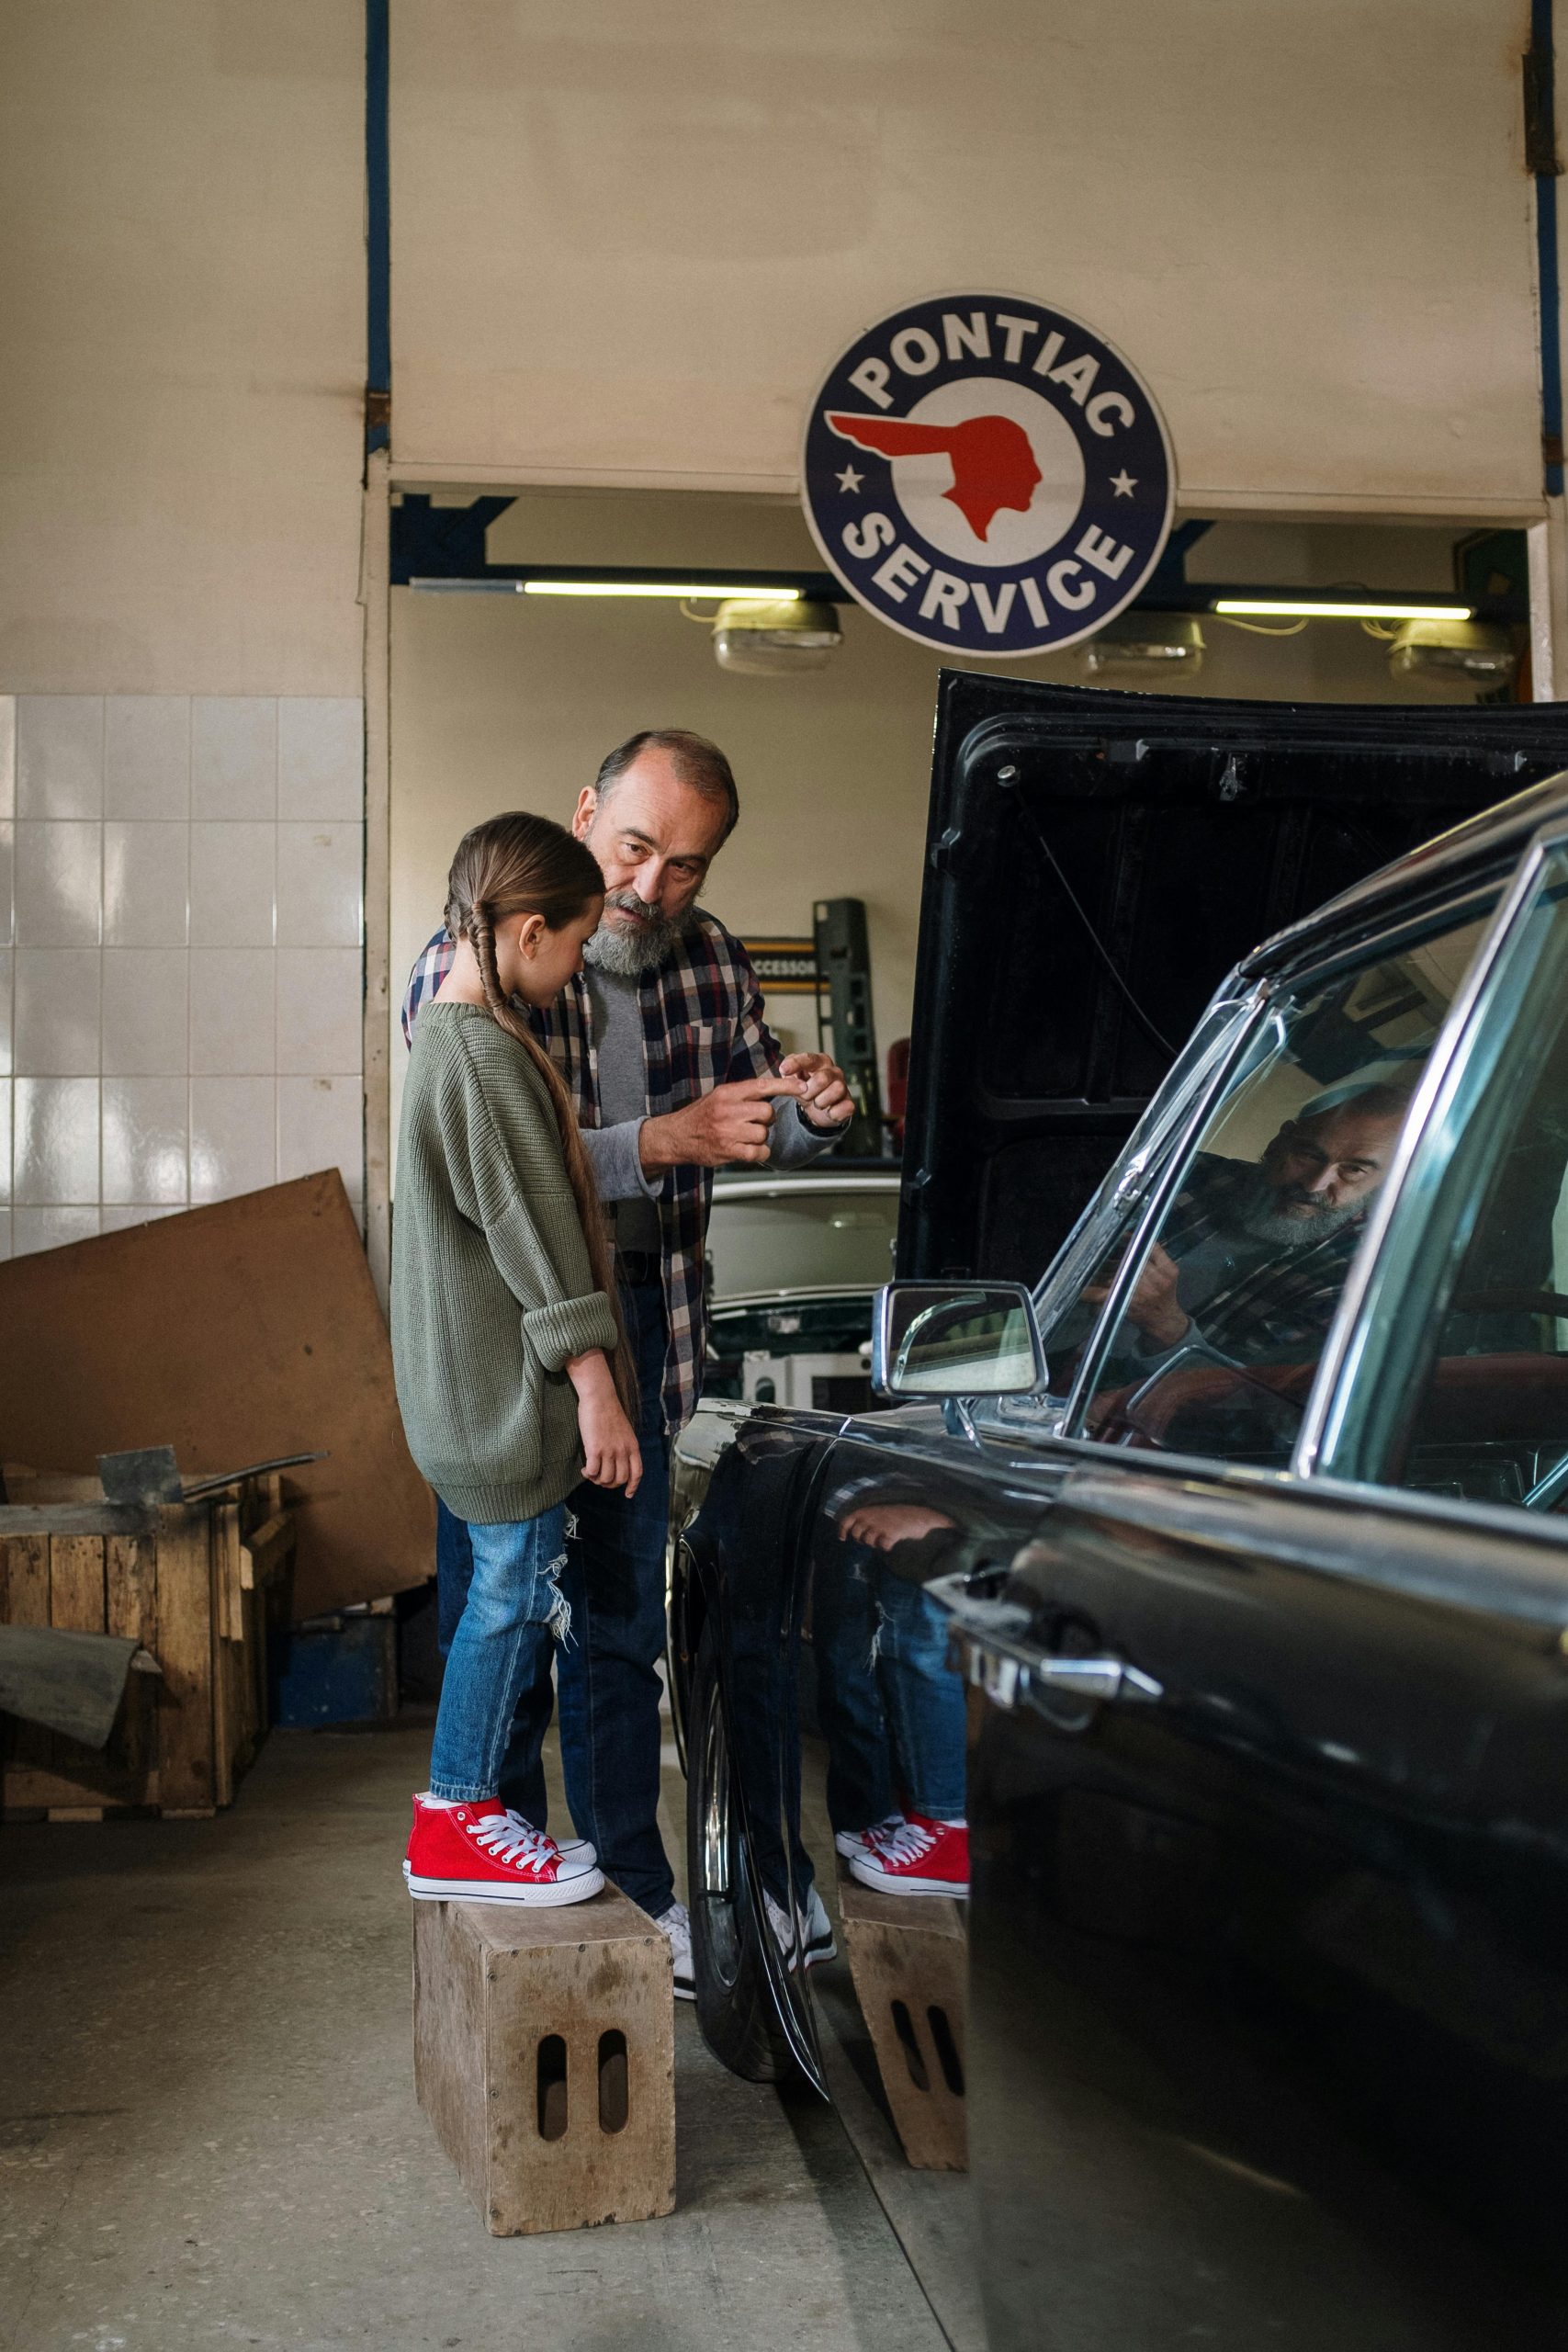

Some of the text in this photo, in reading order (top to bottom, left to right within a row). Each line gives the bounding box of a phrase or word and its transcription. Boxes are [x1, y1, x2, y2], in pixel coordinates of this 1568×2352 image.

[848, 311, 1135, 436] PONTIAC
[841, 512, 1135, 634] SERVICE
[750, 959, 817, 976] CCESSOR
